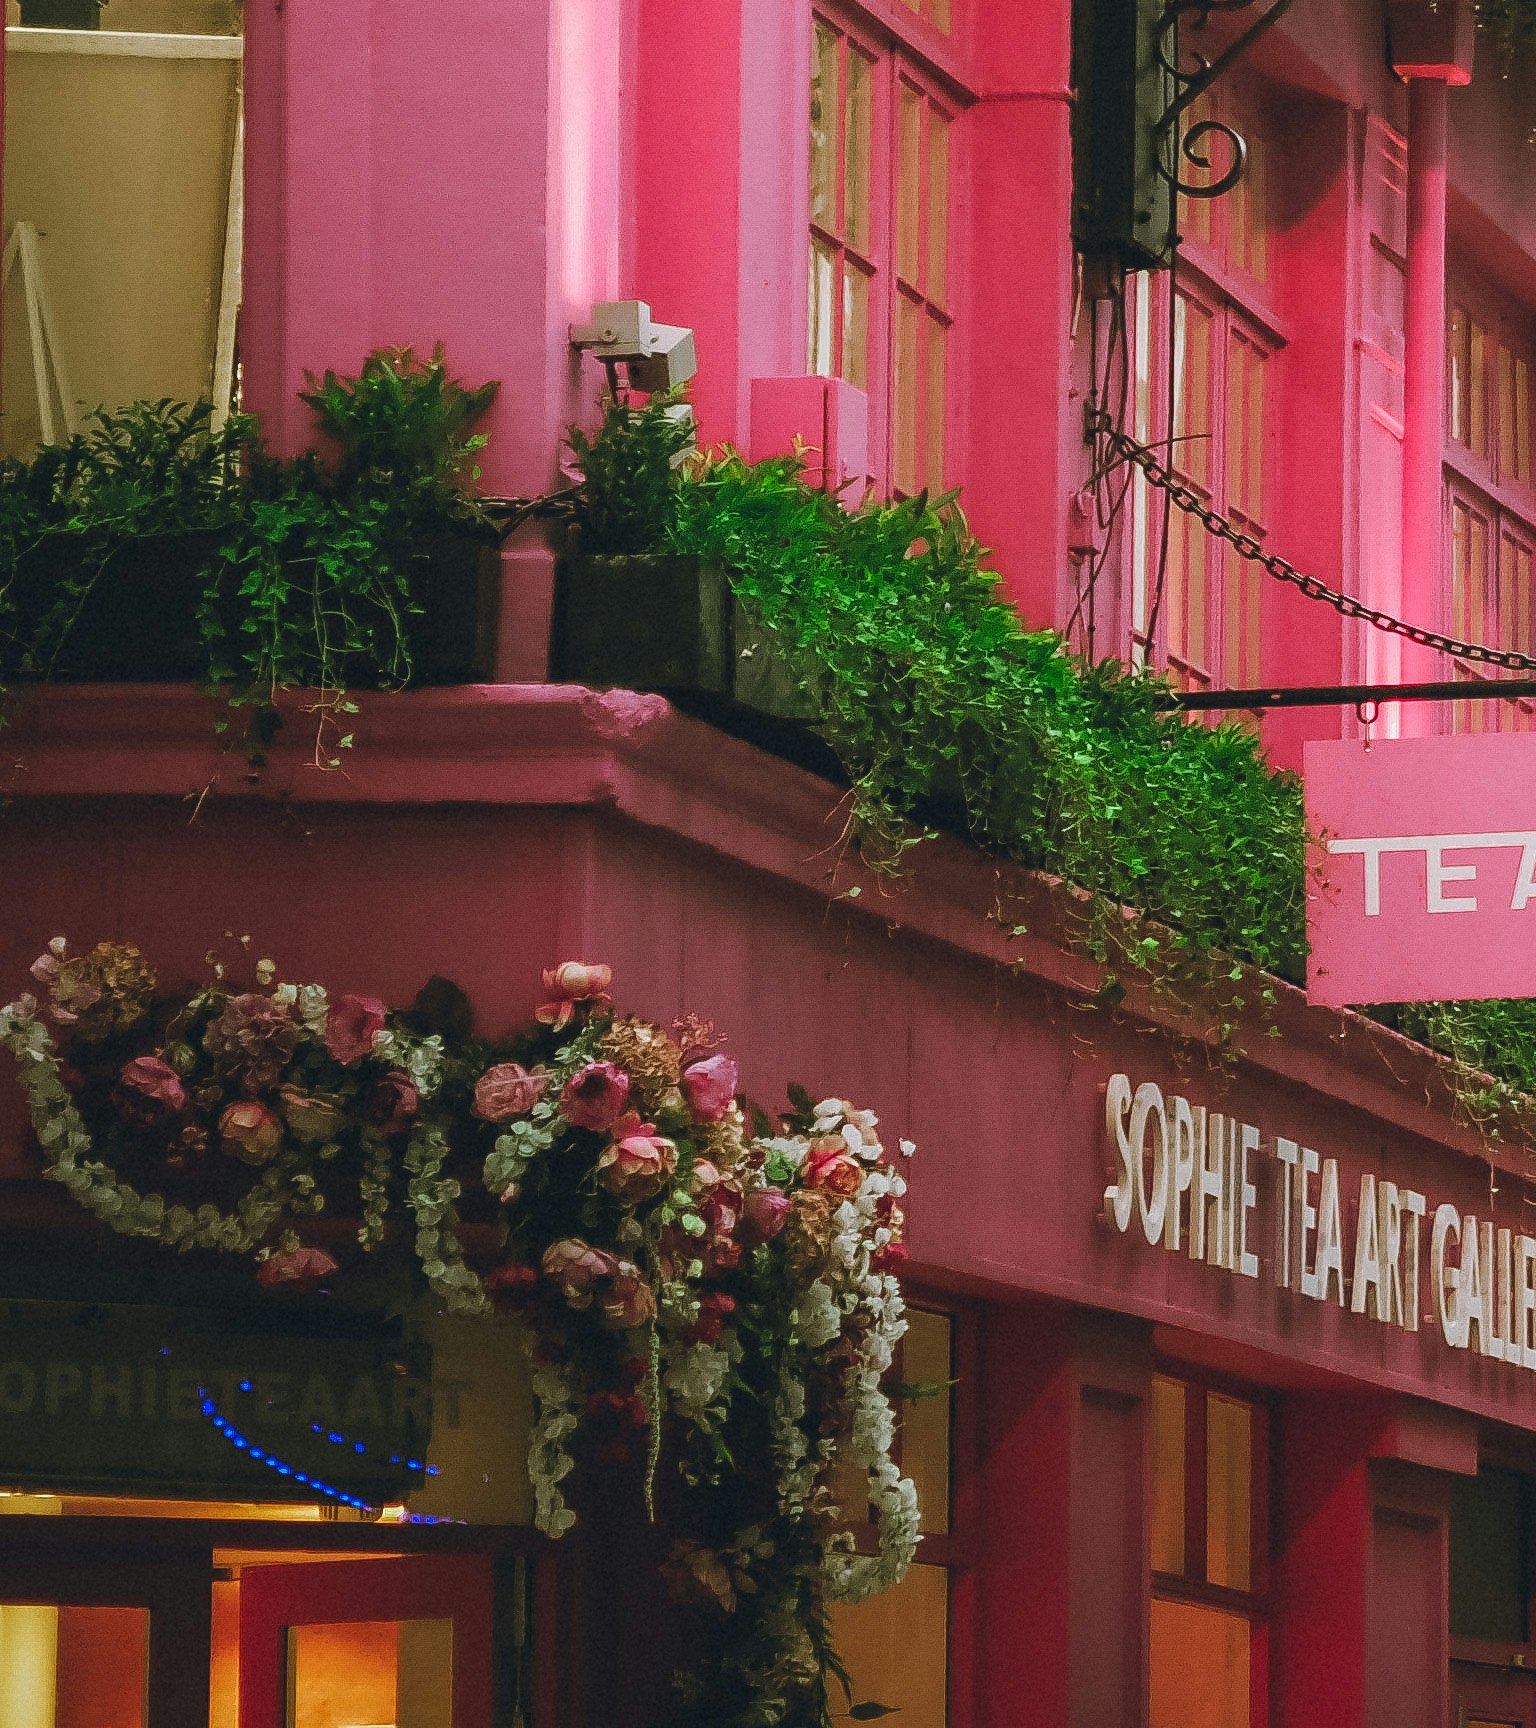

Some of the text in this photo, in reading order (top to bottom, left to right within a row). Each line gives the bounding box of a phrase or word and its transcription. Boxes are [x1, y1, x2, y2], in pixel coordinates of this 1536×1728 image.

[1104, 1073, 1259, 1278] SOPHIE
[1271, 1136, 1344, 1307] TEA
[1351, 1174, 1425, 1331] ART
